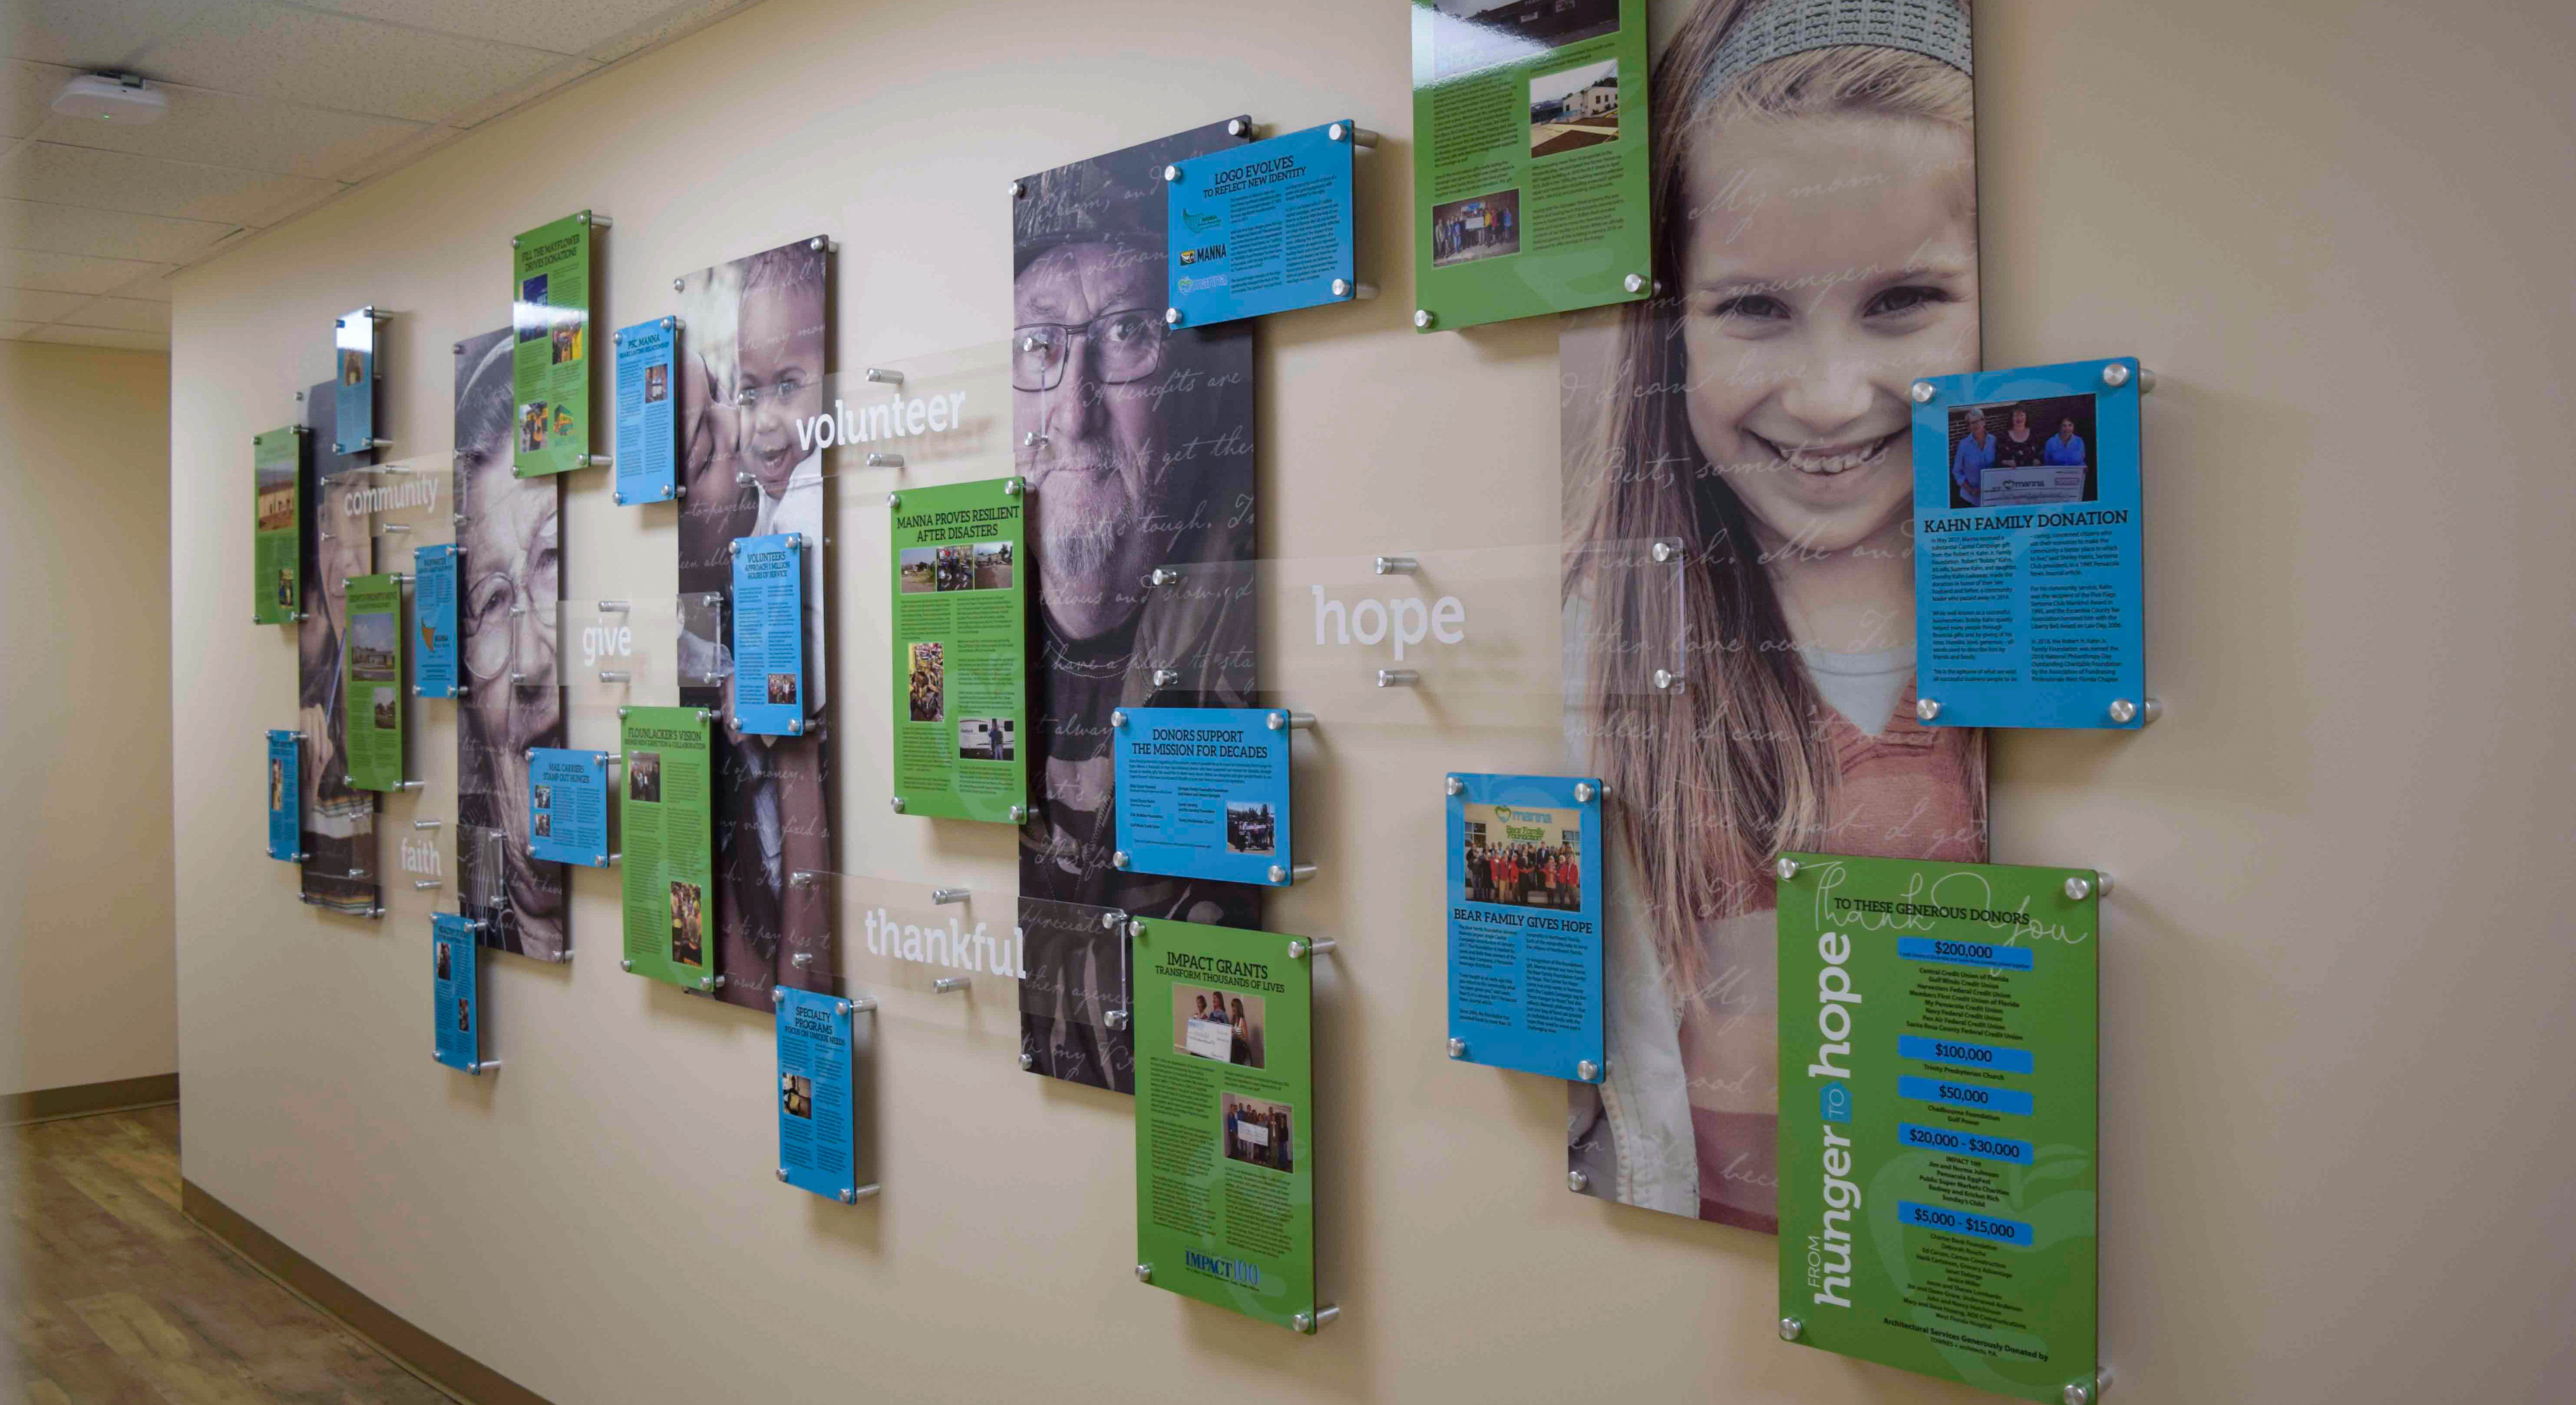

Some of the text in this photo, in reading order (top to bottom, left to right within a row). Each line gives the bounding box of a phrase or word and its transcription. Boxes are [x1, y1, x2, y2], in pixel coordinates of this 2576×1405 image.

[1204, 167, 1306, 198] TO REFLECT NEW IDENTITY
[1215, 156, 1293, 185] LOGO EVOLVES
[1197, 244, 1227, 262] MANNA
[796, 391, 966, 451] volunteer
[344, 473, 438, 516] community
[897, 506, 1020, 529] MANNA PROVES RESILIENT
[1924, 510, 2128, 533] KAHN FAMILY DONATION
[917, 524, 998, 542] AFTER DISASTERS
[747, 551, 786, 563] VOLUNTEERS
[1311, 584, 1465, 661] hope
[583, 617, 632, 666] give
[679, 731, 702, 741] VISION
[1153, 729, 1243, 742] DONORS SUPPORT
[1133, 743, 1268, 759] THE MISSION FOR DECADES
[1512, 811, 1552, 823] manna
[401, 837, 442, 876] faith
[1454, 908, 1592, 934] BEAR FAMILY GIVES HOPE
[1798, 861, 2088, 976] Thank You
[1834, 898, 2030, 925] TO THESE GENEROUS DONORS
[865, 908, 1026, 979] thankful
[1935, 940, 1992, 959] $200,000
[1167, 952, 1268, 979] IMPACT GRANTS
[1155, 966, 1285, 993] TRANSFORM THOUSANDS OF LIVES
[795, 1017, 833, 1035] PROGRAMS
[796, 1006, 830, 1022] SPECIALTY
[1935, 1043, 1992, 1064] $100,000
[1939, 1085, 1988, 1104] $50,000
[1807, 931, 1862, 1308] FROM hunger TO hope
[1910, 1128, 1958, 1148] $20,000
[1968, 1138, 2020, 1158] $30,000
[1915, 1208, 1955, 1227] $5,000
[1966, 1217, 2015, 1238] $15,000
[1185, 1250, 1232, 1278] IMPACT
[1233, 1257, 1260, 1285] 100
[1883, 1317, 1929, 1334] Architectural
[1930, 1327, 1960, 1340] Services
[1962, 1333, 2002, 1351] Generously
[2005, 1342, 2037, 1356] Donated
[2038, 1349, 2048, 1360] by
